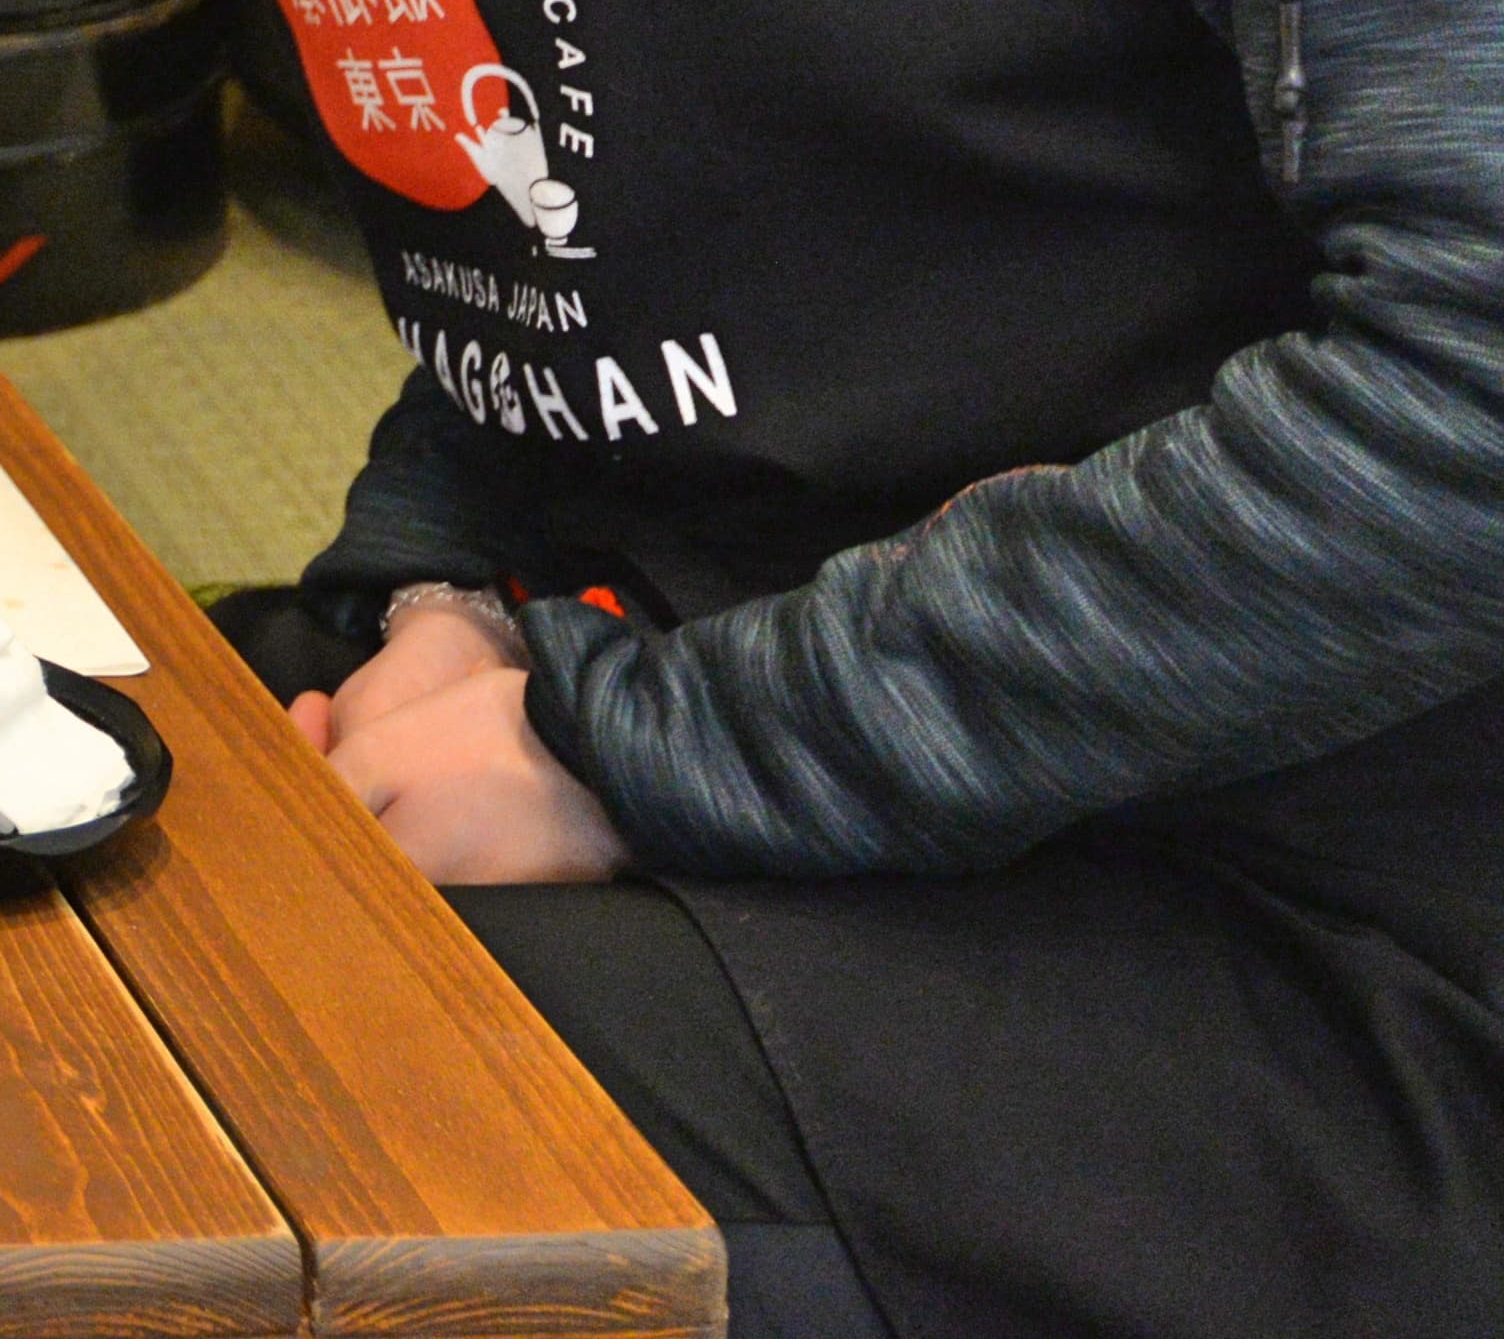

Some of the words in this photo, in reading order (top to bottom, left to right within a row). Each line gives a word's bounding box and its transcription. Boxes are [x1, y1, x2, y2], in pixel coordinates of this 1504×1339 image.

[336, 45, 447, 133] 東京
[400, 250, 500, 313] ASAKUSA
[506, 280, 589, 333] JAPAN
